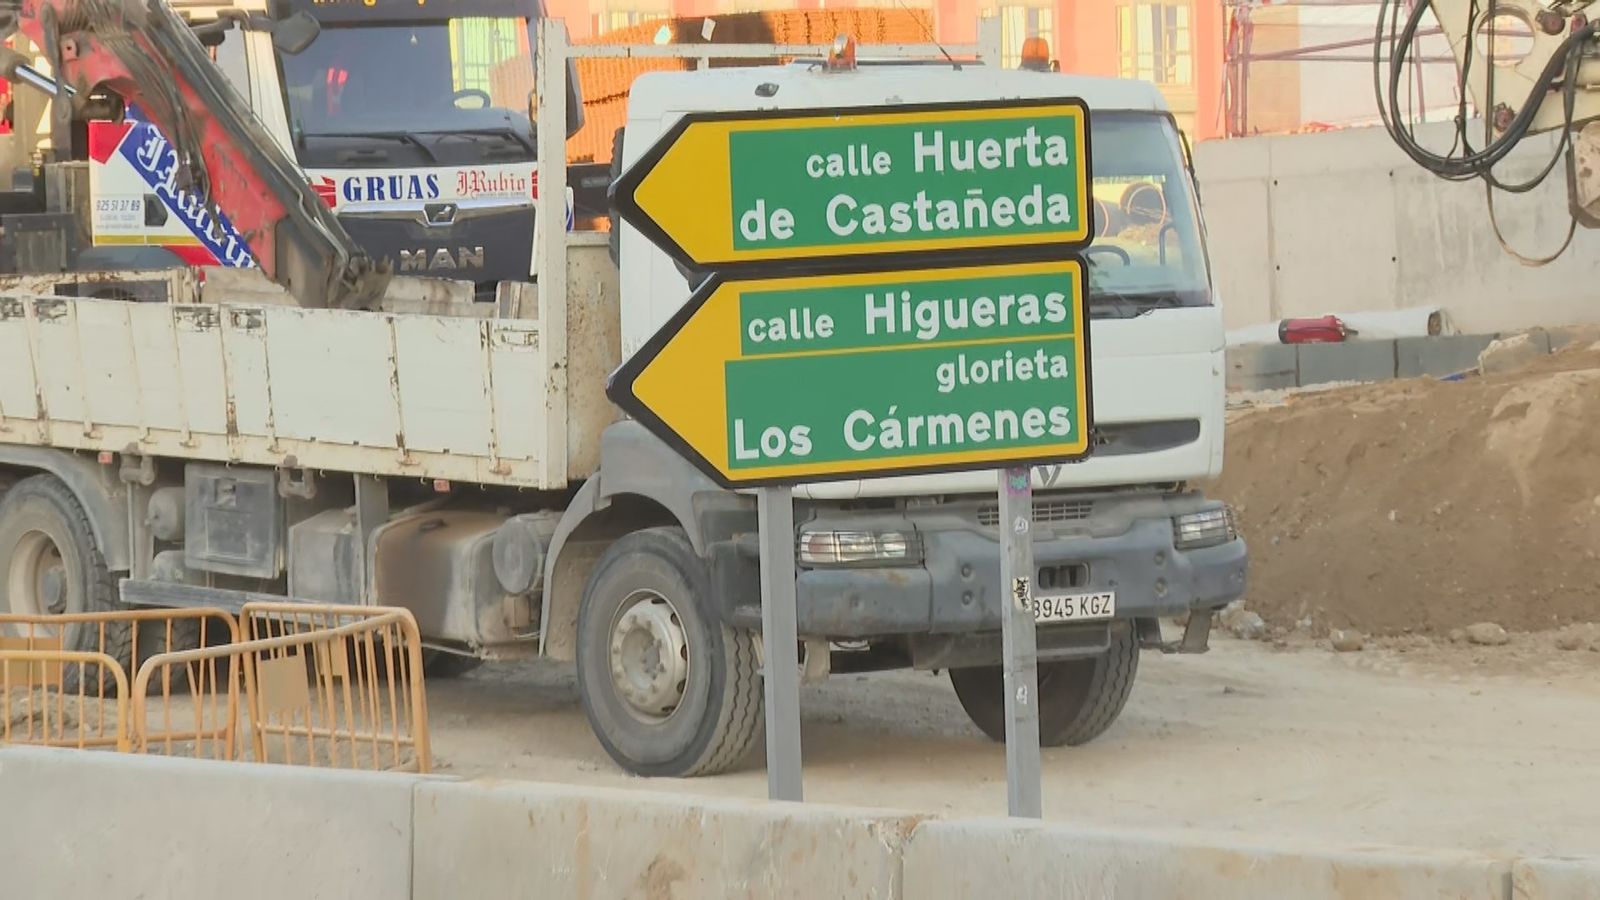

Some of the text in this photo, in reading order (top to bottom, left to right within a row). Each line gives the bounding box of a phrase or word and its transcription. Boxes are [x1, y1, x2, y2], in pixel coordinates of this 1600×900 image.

[807, 126, 1069, 179] calle Huerta
[343, 174, 440, 202] GRUAS
[740, 184, 1071, 241] de Castañeda
[400, 246, 484, 272] MAN
[748, 291, 1067, 342] calle Higueras
[936, 349, 1069, 393] glorieta
[734, 405, 1071, 460] Los Cármenes
[1080, 594, 1112, 616] KGZ
